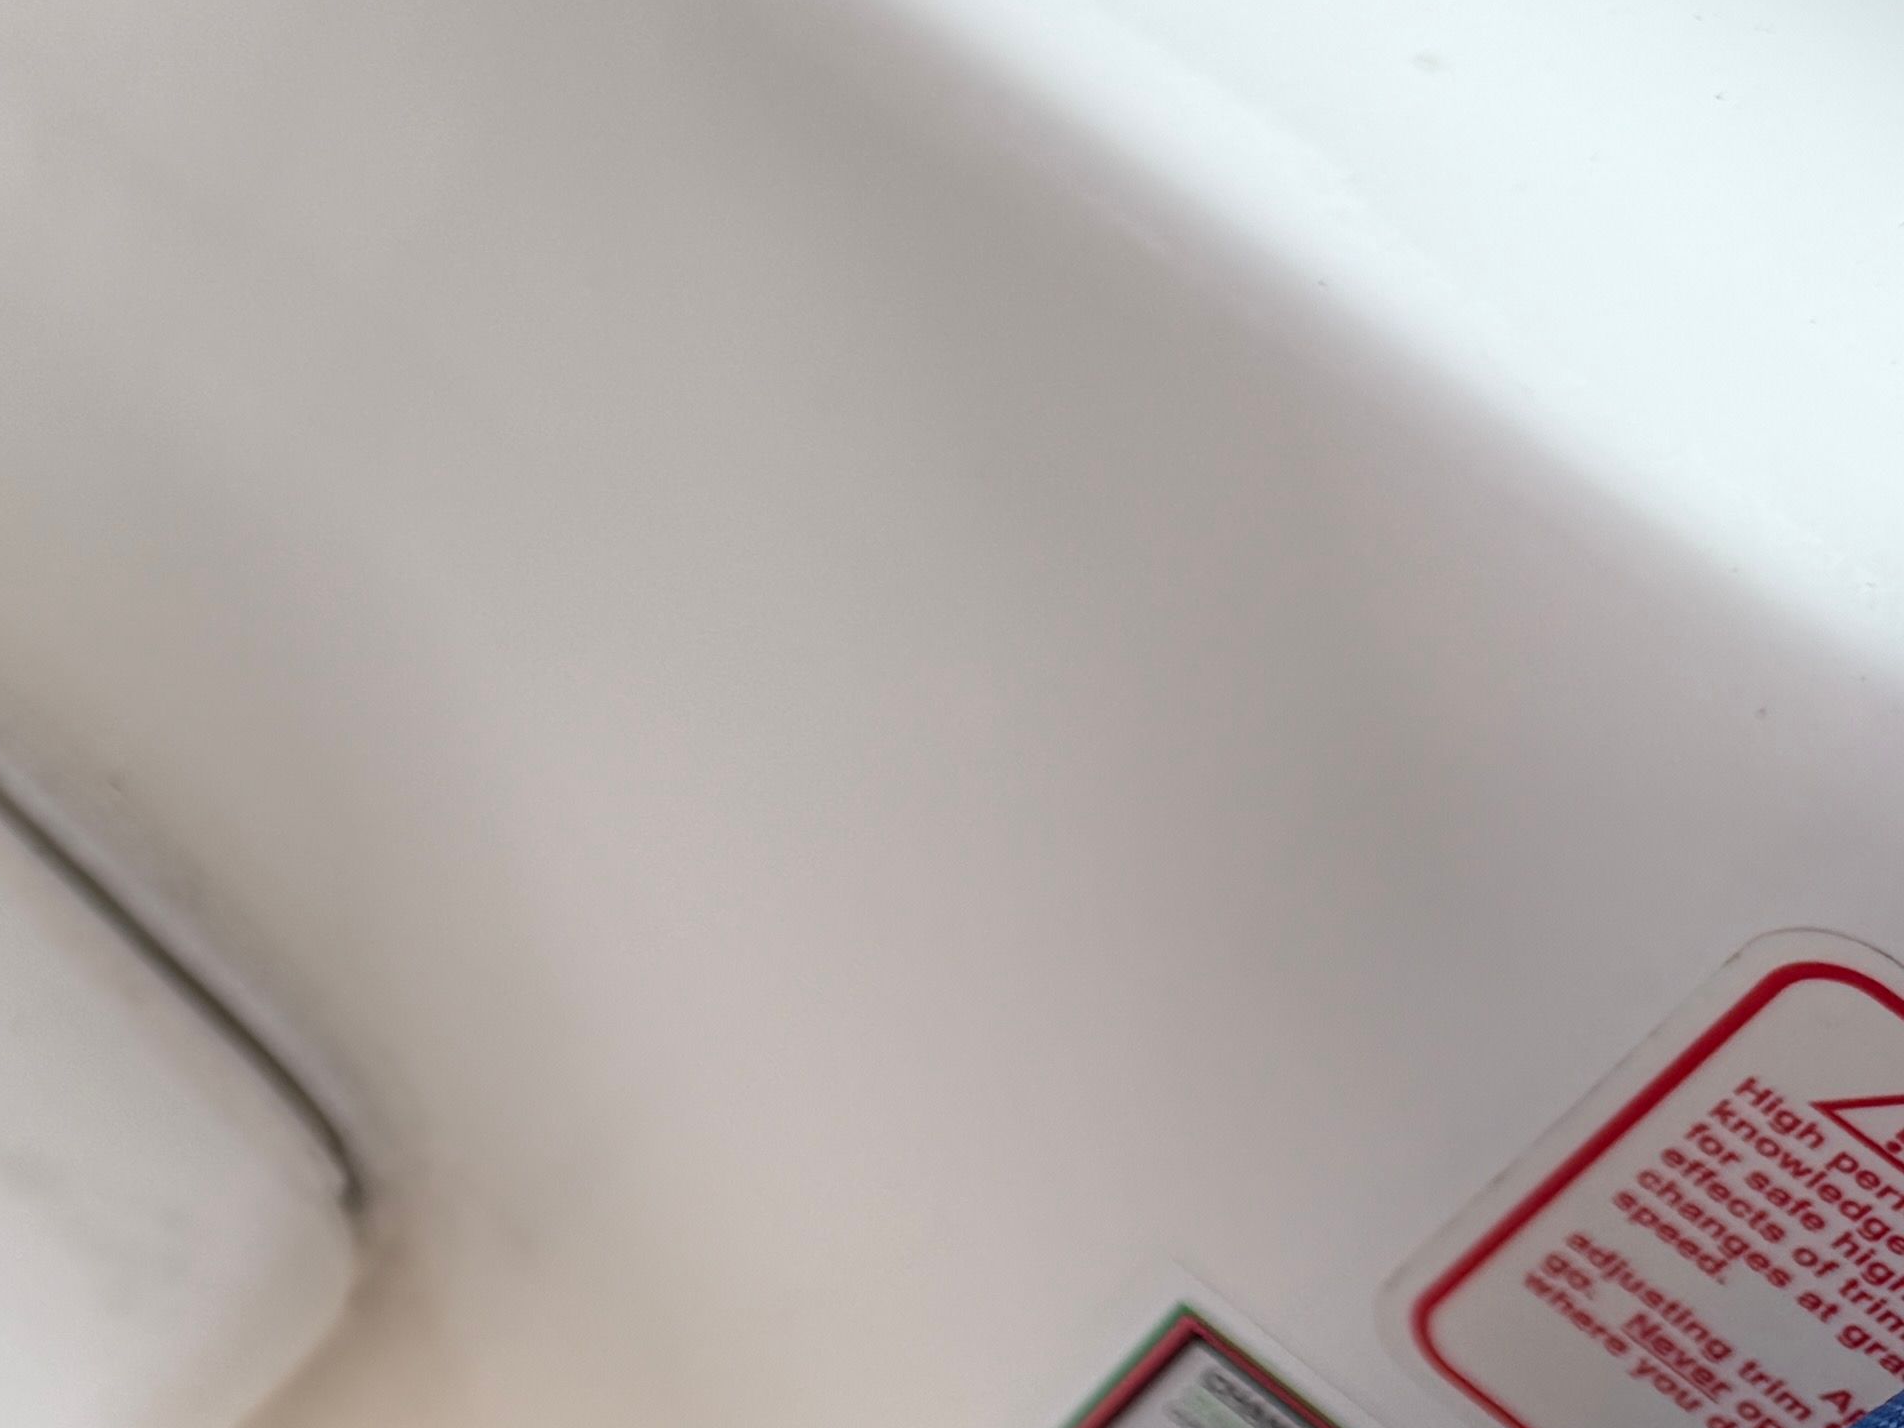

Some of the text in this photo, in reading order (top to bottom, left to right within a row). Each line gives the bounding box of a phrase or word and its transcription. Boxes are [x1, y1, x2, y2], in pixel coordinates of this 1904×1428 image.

[1685, 1121, 1744, 1166] for
[1744, 1170, 1826, 1233] safe
[1708, 1097, 1904, 1257] knowledge
[1733, 1074, 1826, 1151] High
[1612, 1189, 1729, 1287] speed.
[1636, 1168, 1793, 1290] changes
[1796, 1290, 1842, 1325] at
[1660, 1146, 1787, 1245] effects
[1791, 1245, 1841, 1279] of
[1523, 1271, 1630, 1358] where
[1627, 1358, 1703, 1414] you
[1542, 1251, 1596, 1300] go.
[1621, 1311, 1735, 1404] Never
[1565, 1231, 1734, 1364] adjusting
[1737, 1358, 1815, 1423] trim
